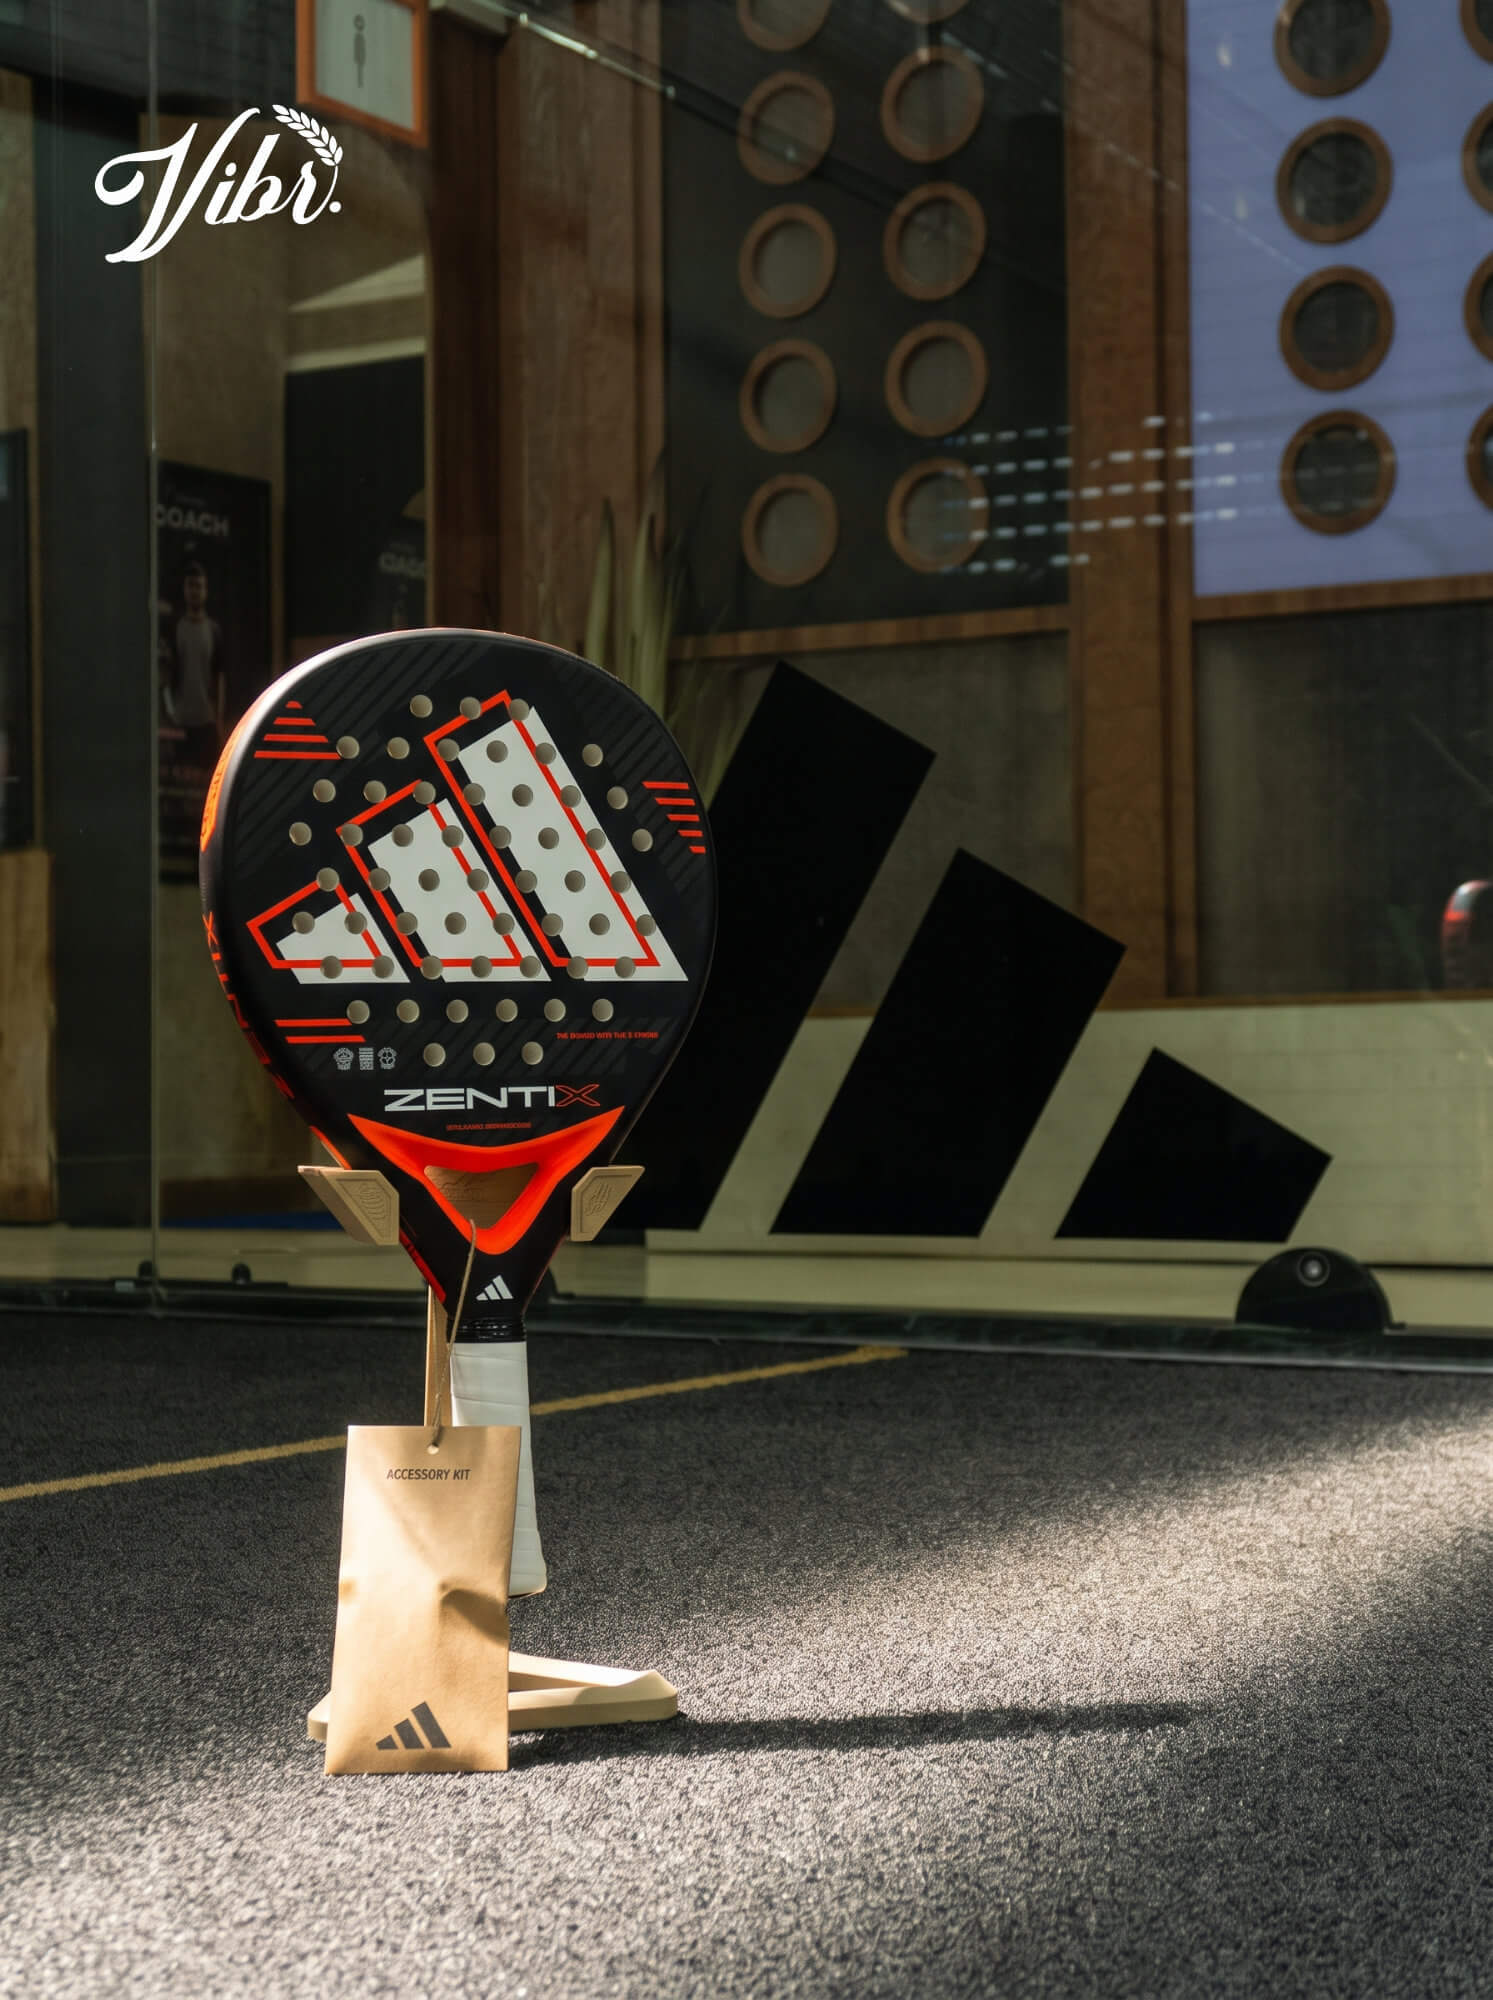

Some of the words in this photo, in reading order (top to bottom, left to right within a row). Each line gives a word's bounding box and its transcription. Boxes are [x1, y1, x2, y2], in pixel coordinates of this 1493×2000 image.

[384, 1083, 601, 1112] ZENTIX
[386, 1468, 450, 1481] ACCESSORY
[452, 1468, 472, 1481] KIT
